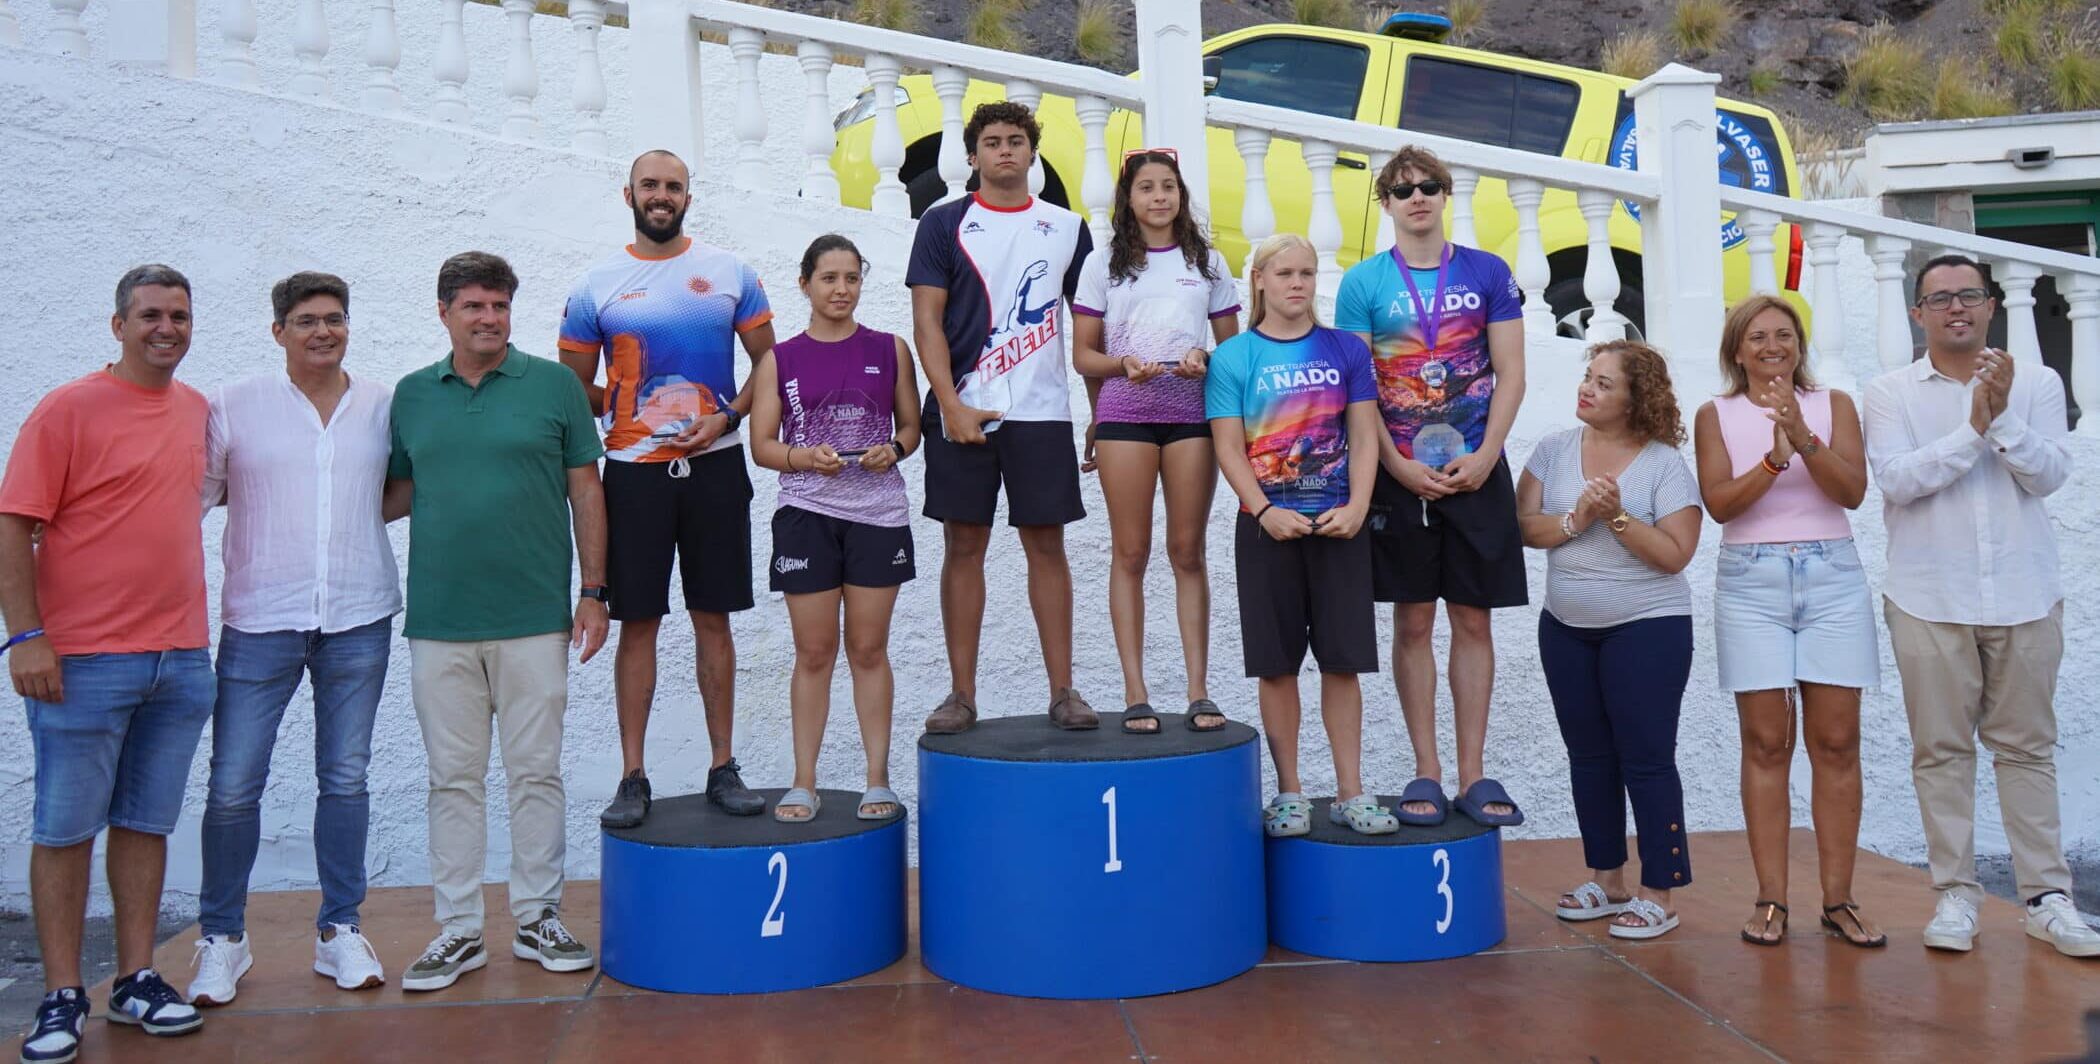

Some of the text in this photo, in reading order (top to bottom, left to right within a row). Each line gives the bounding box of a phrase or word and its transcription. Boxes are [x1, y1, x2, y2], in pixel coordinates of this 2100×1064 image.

[1716, 114, 1770, 187] LVASER
[1388, 300, 1404, 318] A
[1256, 368, 1340, 395] A NADO
[1302, 478, 1328, 487] NADO
[1102, 786, 1122, 873] 1
[761, 851, 788, 937] 2
[1433, 848, 1453, 934] 3
